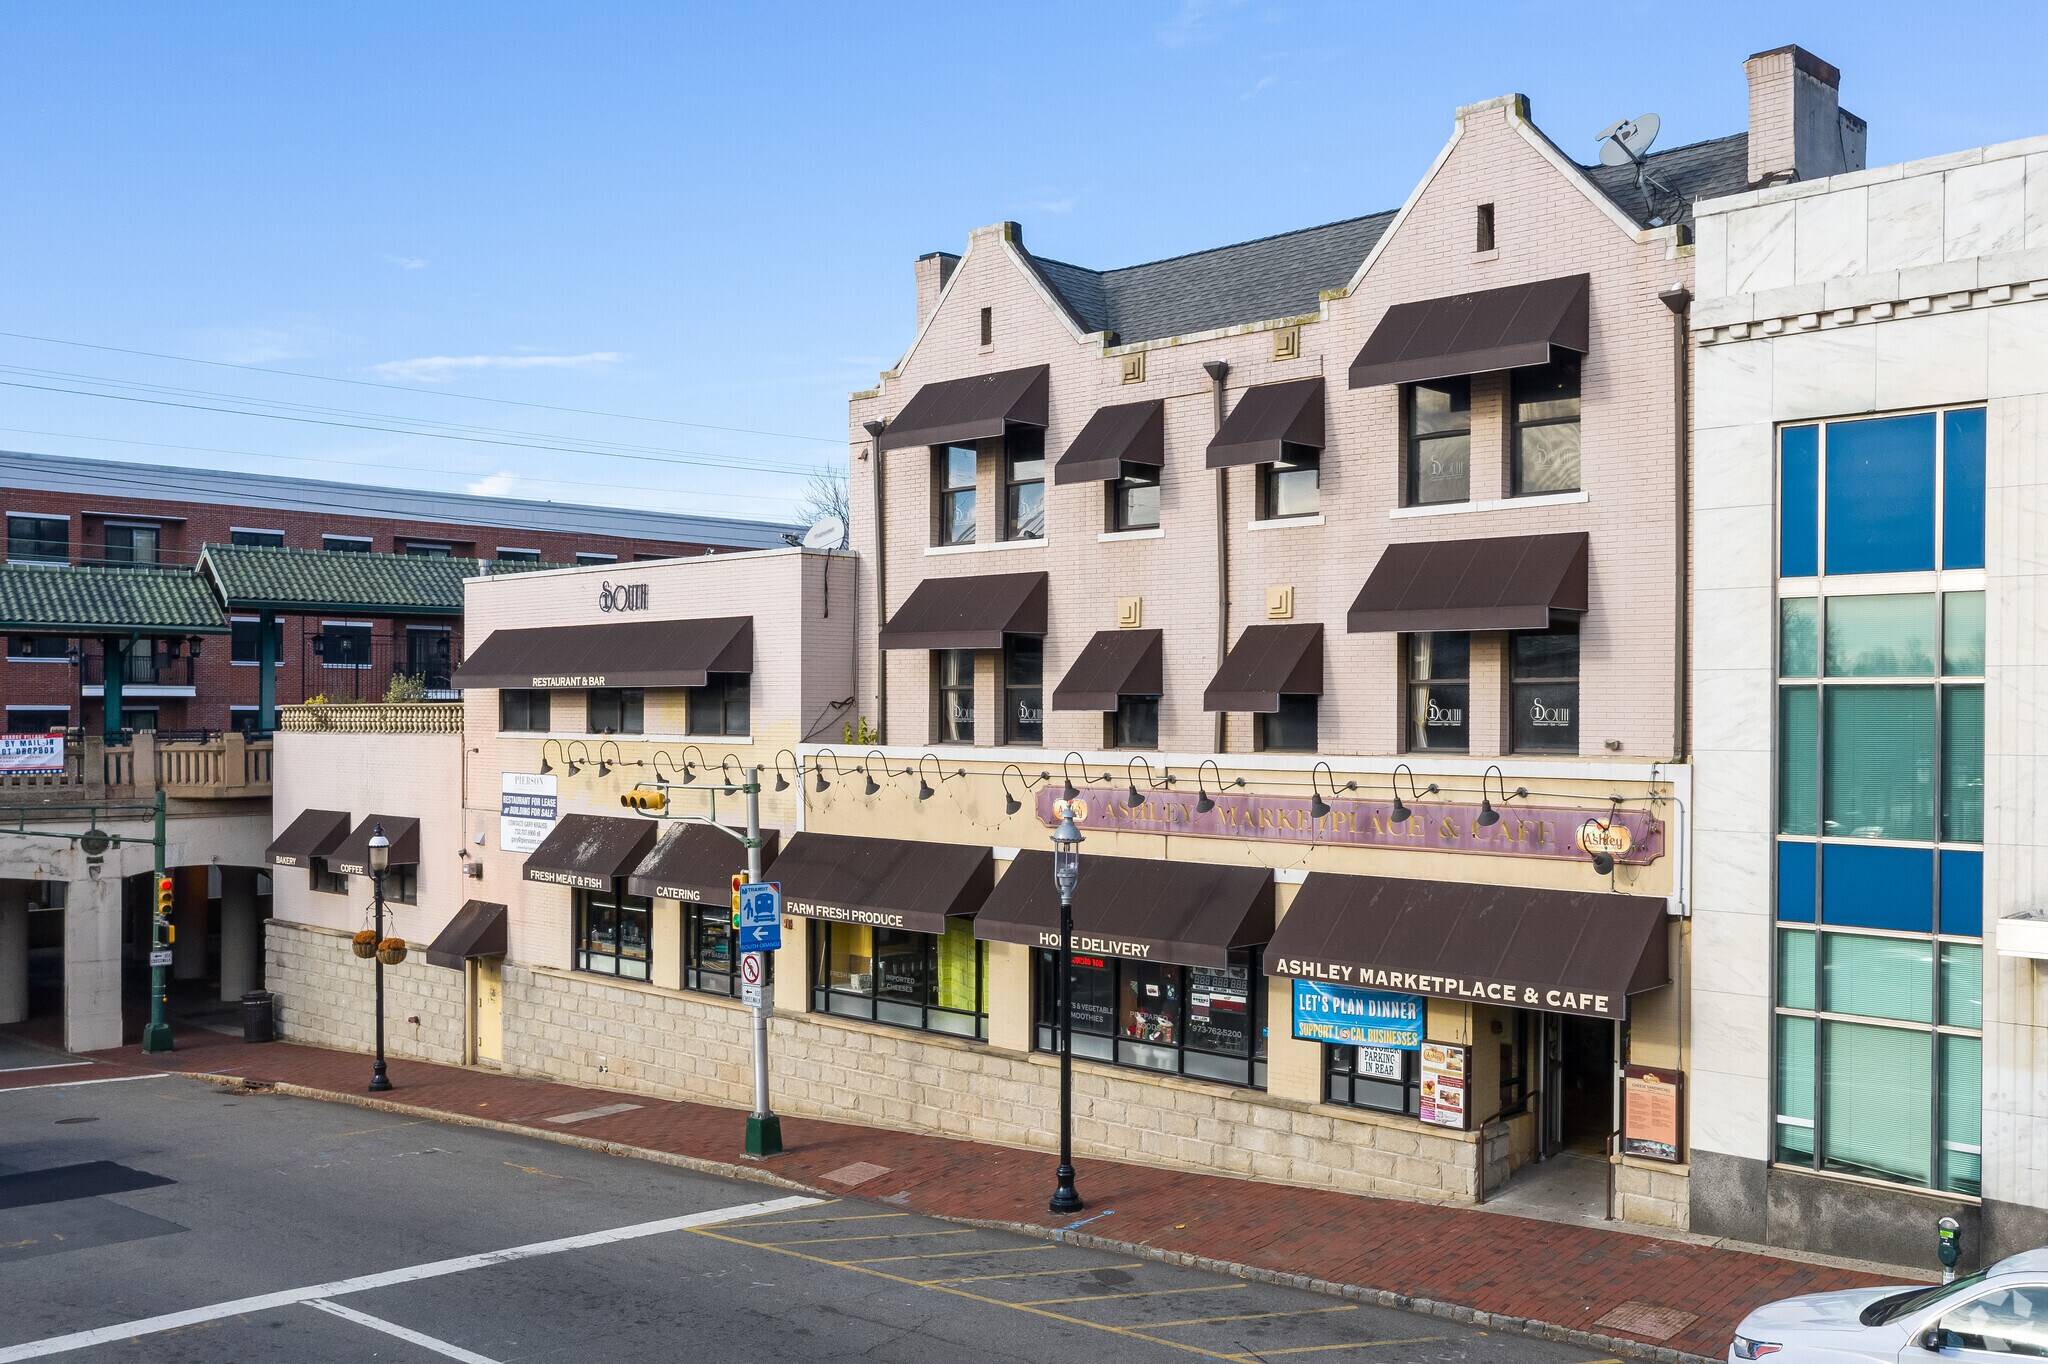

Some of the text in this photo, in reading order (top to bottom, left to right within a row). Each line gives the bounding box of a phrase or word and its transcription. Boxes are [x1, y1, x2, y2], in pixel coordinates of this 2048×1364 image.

[532, 676, 606, 687] RESTAURANT & BAR
[5, 740, 15, 748] BY
[16, 747, 54, 755] DROPBOX
[503, 796, 556, 808] RESTAURANT FOR LEASE
[509, 806, 531, 816] BUILDING
[531, 807, 541, 817] FOR
[541, 808, 554, 818] SALE
[1105, 801, 1191, 824] ASHLEY
[1439, 816, 1459, 838] &
[1584, 833, 1623, 850] Ashley
[275, 855, 297, 865] BAKERY
[340, 864, 364, 874] COFFEE
[530, 870, 602, 889] FRESH MEAT & FISH
[656, 886, 700, 901] CATERING
[786, 901, 904, 928] FARM FRESH PRODUCE
[1081, 938, 1150, 958] DELIVERY
[885, 974, 915, 985] IMPORTED
[1276, 958, 1609, 1013] ASHLEY MARKETPLACE & CAFE
[886, 983, 913, 993] CHEESES
[1081, 1004, 1114, 1015] VEGETABLE
[1299, 993, 1417, 1020] LET'S PLAN DINNER
[1070, 1011, 1104, 1023] MOOTHIES
[1192, 1024, 1242, 1038] 973-762-5200
[1299, 1022, 1334, 1038] SUPPORT
[1367, 1031, 1418, 1047] BUSINESSES
[1364, 1050, 1396, 1065] PARKING
[1365, 1062, 1394, 1076] IN REAR
[1647, 1085, 1671, 1093] SANDWICHES
